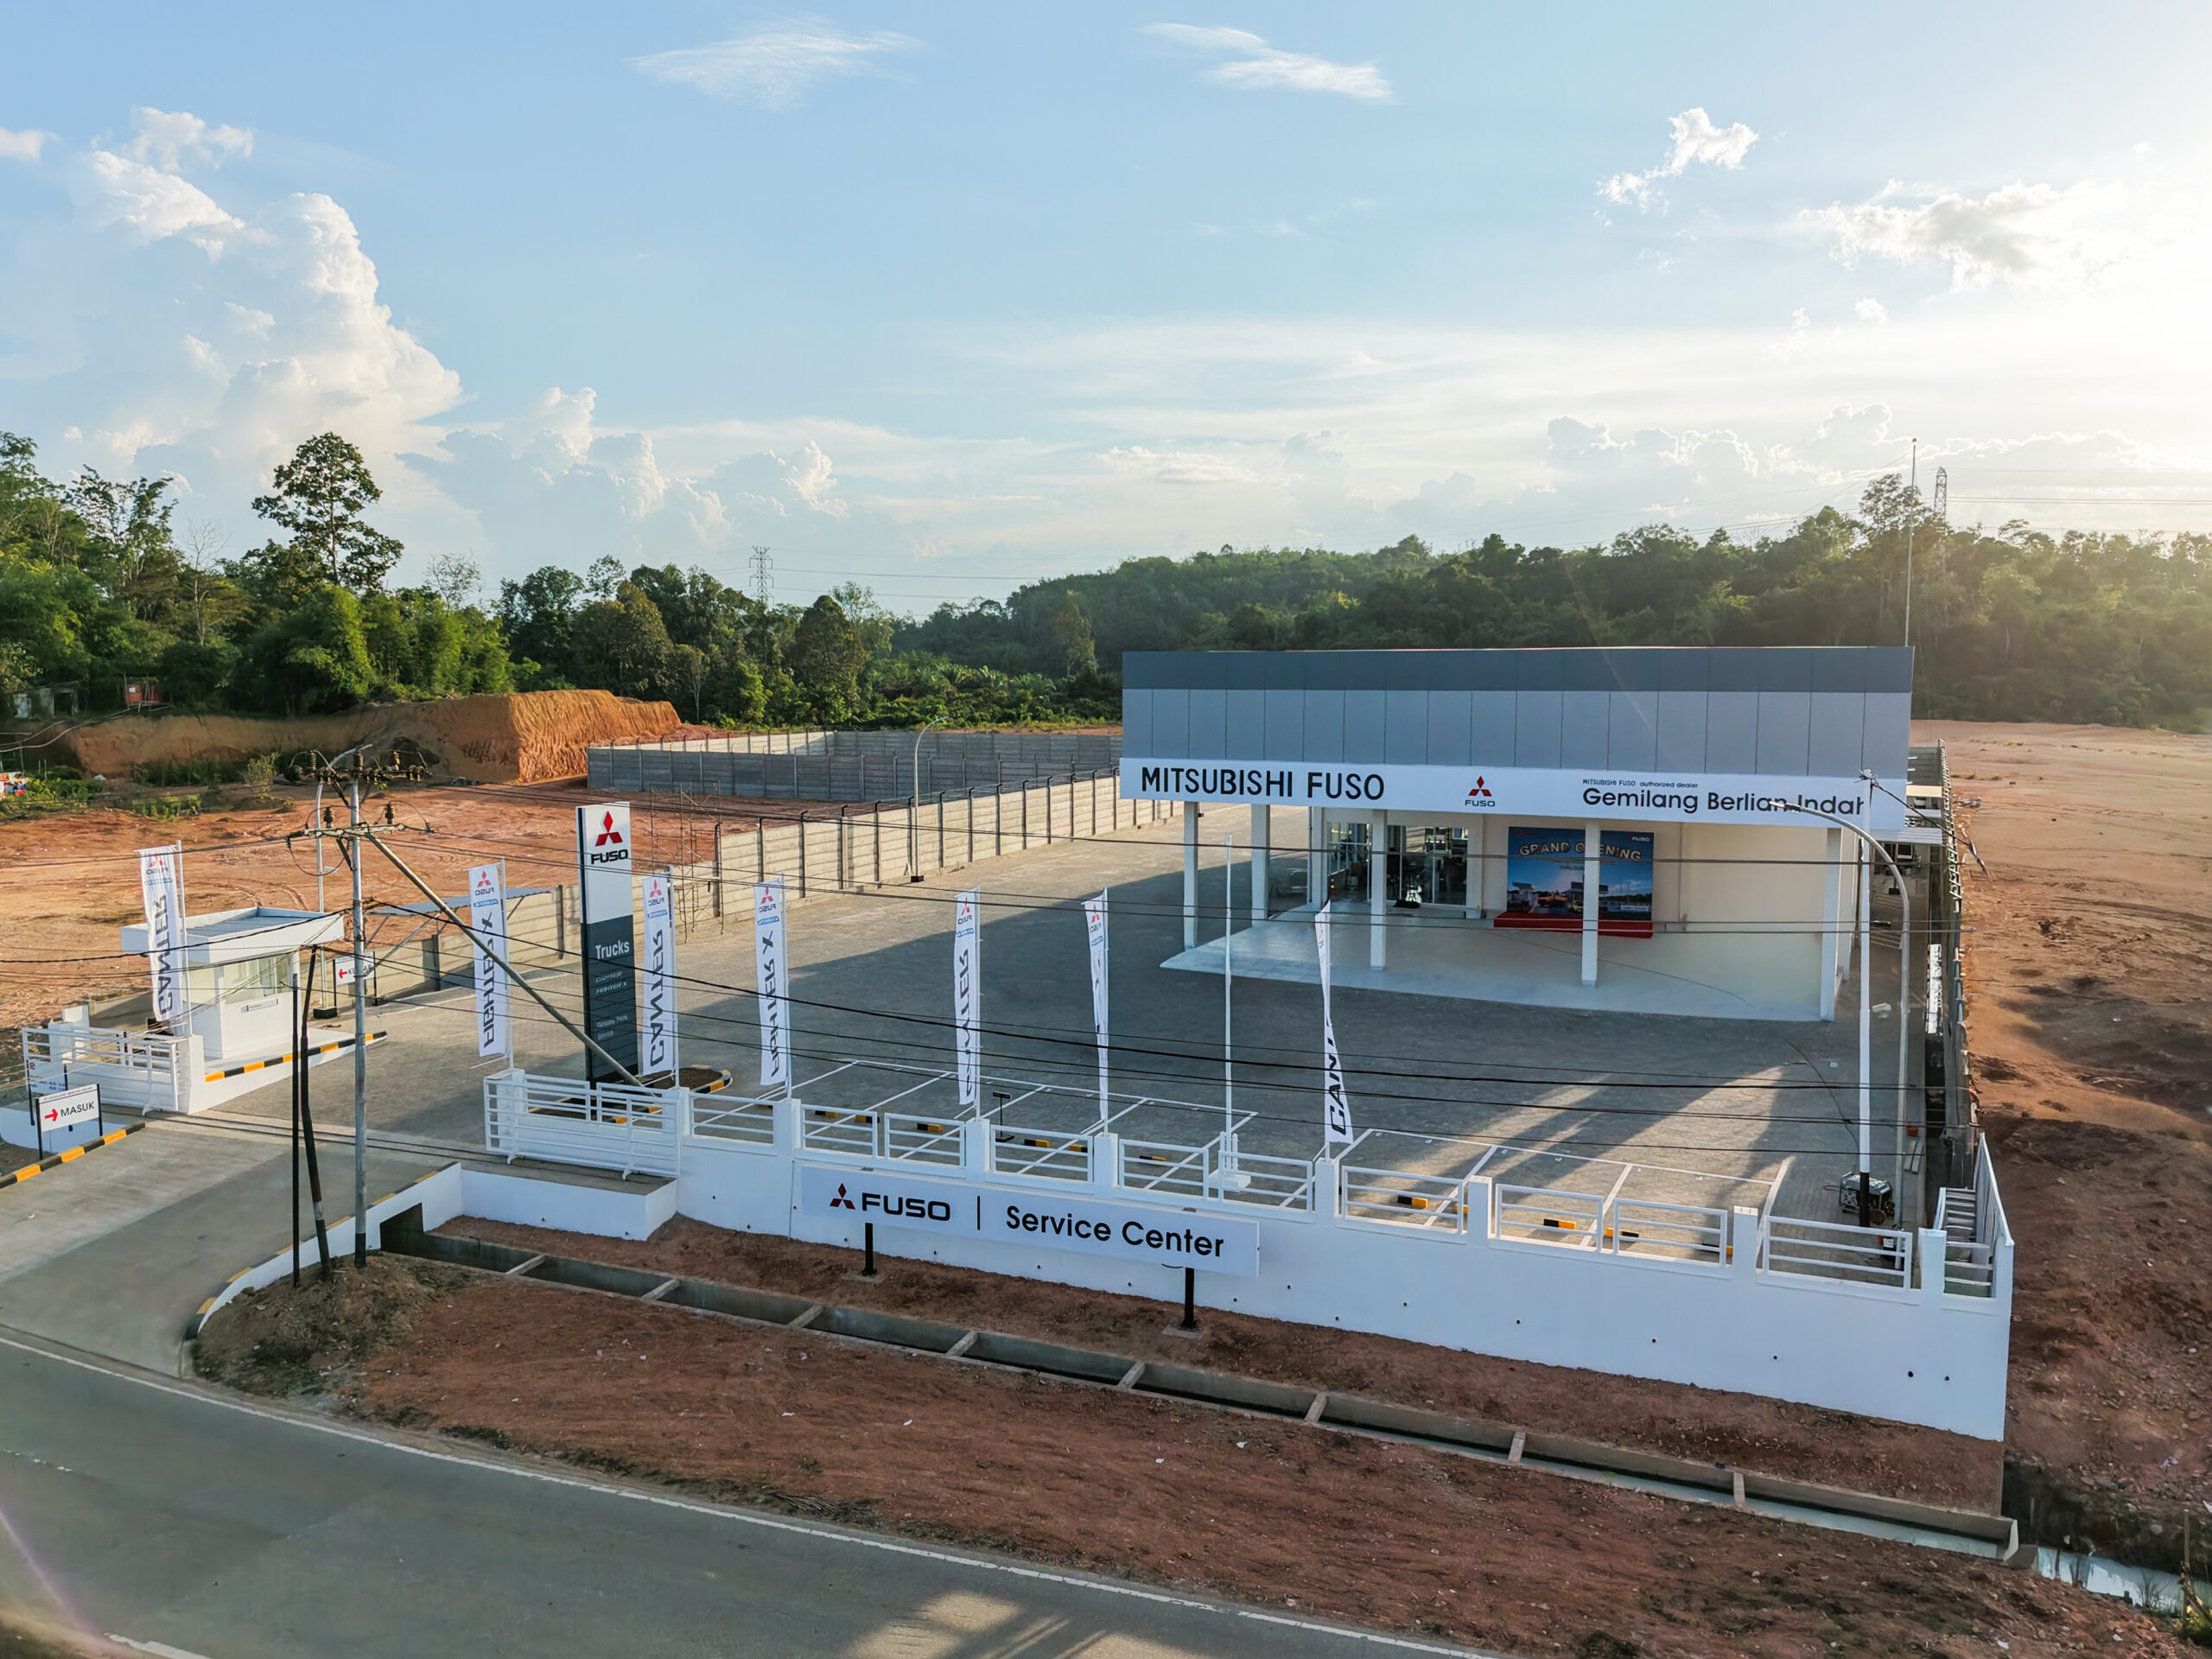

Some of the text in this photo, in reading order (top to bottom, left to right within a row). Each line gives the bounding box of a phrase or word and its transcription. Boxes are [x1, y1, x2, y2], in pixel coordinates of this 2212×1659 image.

[1141, 767, 1385, 800] MITSUBISHI FUSO
[1582, 787, 1699, 814] Gemilang
[1707, 791, 1788, 811] Berlian
[590, 849, 629, 865] FUSO
[1519, 842, 1571, 857] GRAND
[1574, 842, 1642, 861] OENING
[594, 939, 630, 960] Trucks
[60, 1101, 95, 1117] MASUK
[861, 1192, 1224, 1257] FUSO Service Center
